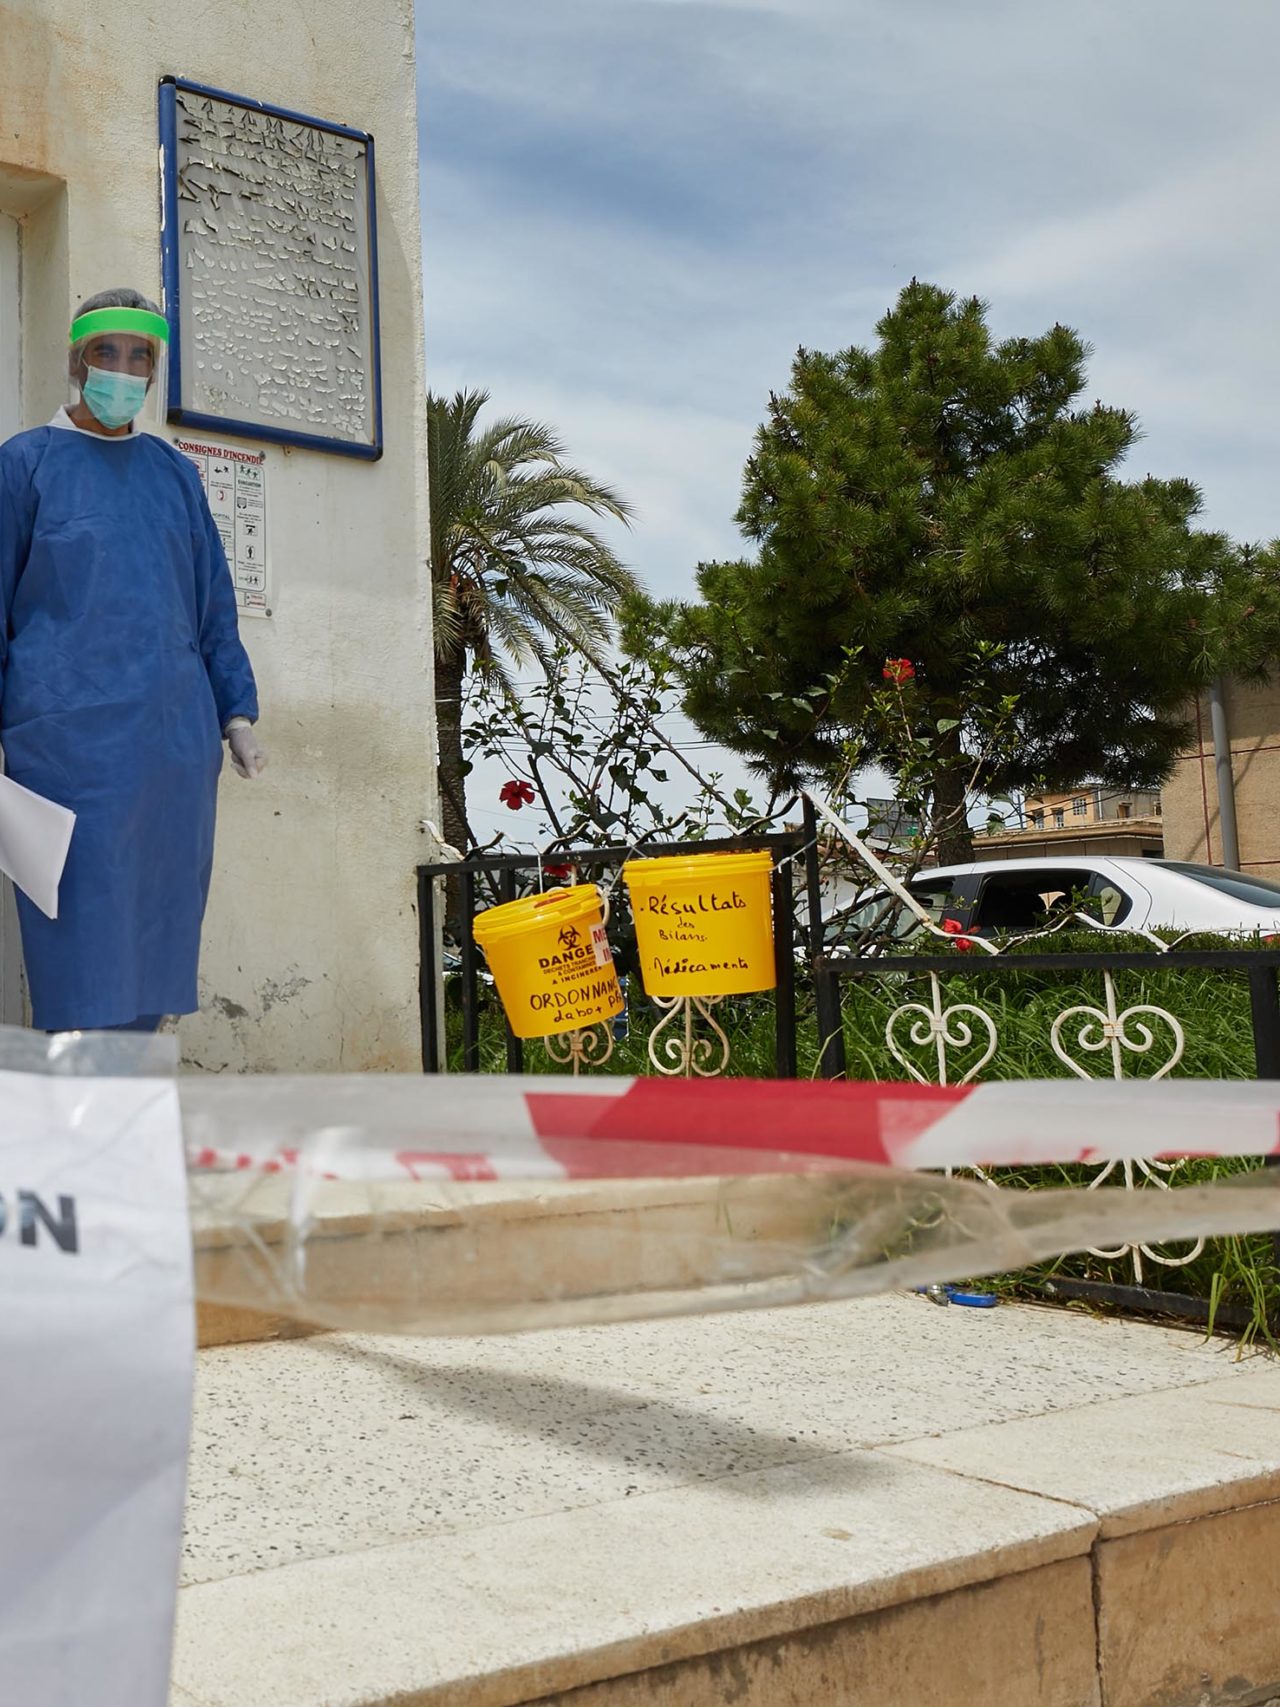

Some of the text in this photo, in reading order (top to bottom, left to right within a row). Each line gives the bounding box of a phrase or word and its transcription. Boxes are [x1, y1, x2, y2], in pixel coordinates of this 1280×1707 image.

[178, 441, 222, 457] CONSIGNES
[648, 891, 747, 915] Résultats
[538, 943, 594, 968] DANGE
